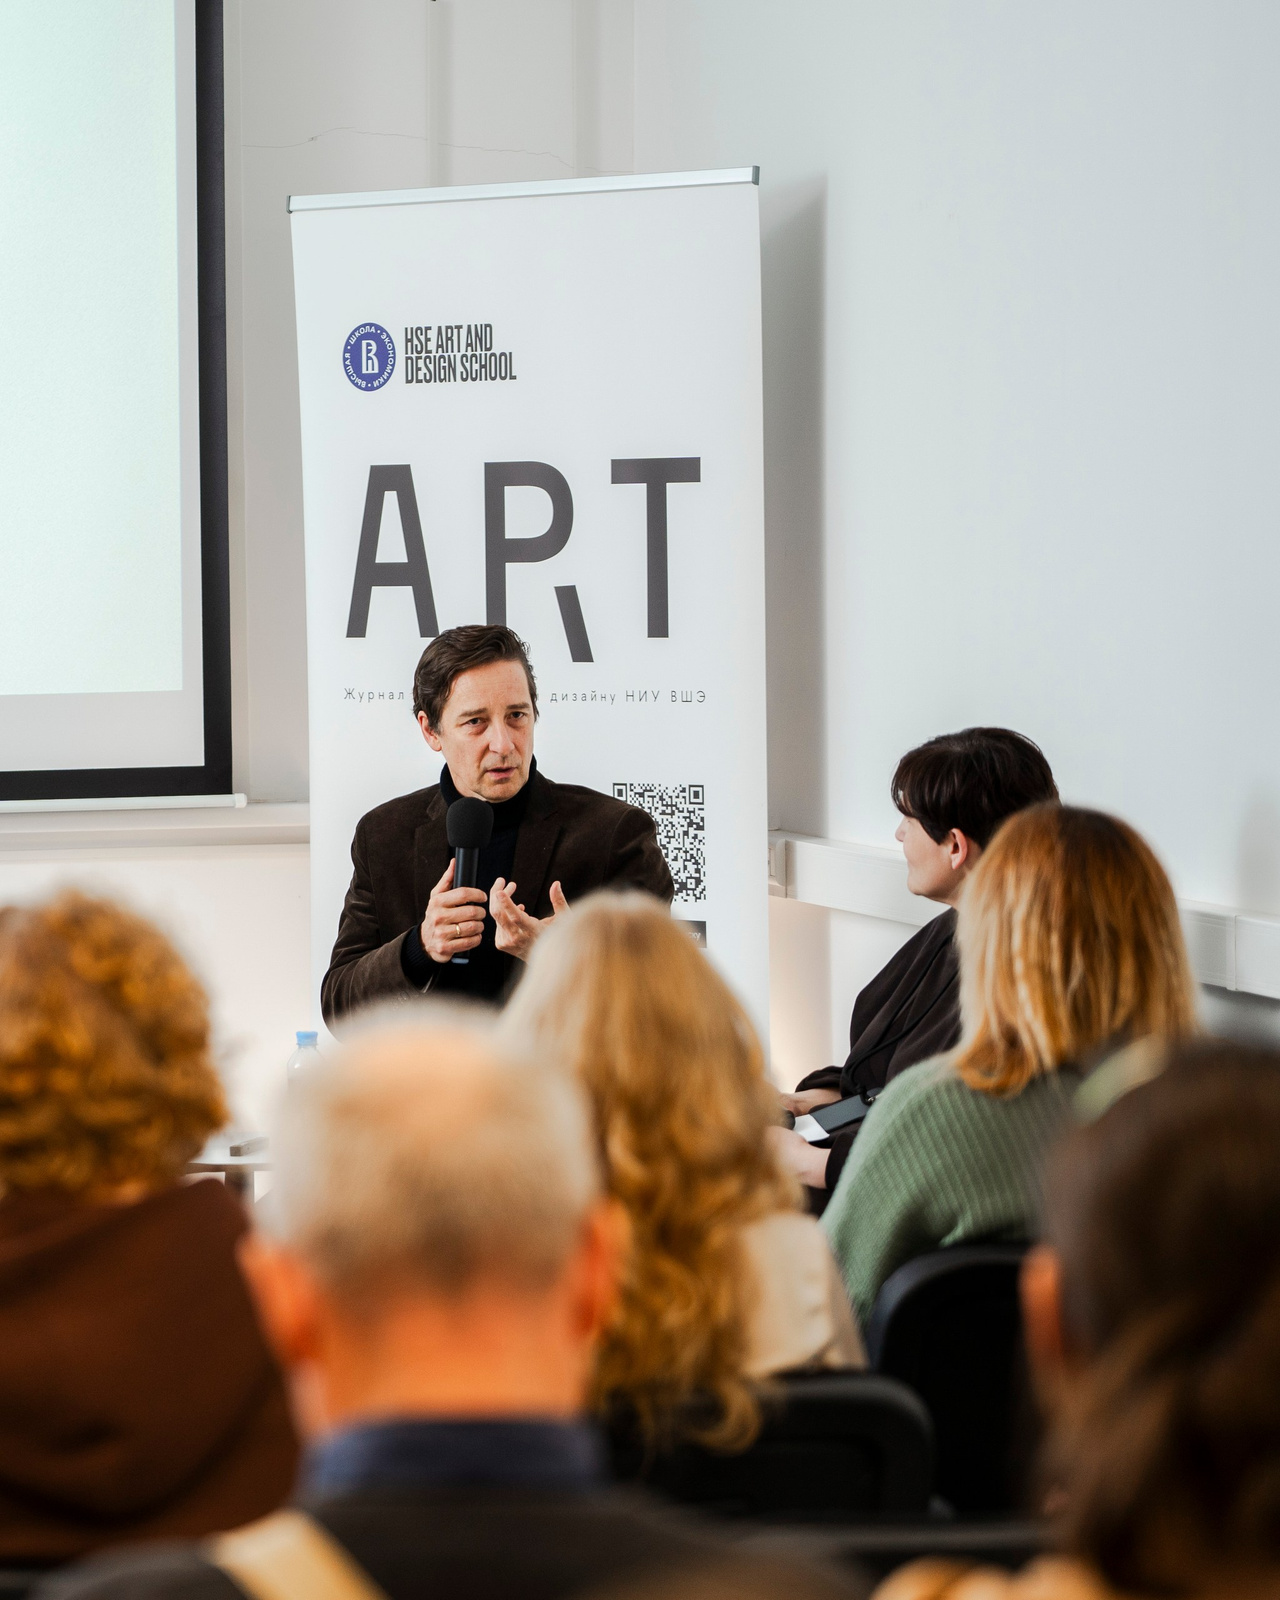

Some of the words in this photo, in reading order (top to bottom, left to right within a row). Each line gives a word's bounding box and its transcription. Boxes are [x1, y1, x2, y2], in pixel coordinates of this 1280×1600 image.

[348, 325, 376, 345] ШКОЛА
[405, 326, 432, 355] HSE
[436, 325, 463, 354] ART
[465, 323, 493, 352] AND
[344, 353, 367, 388] ВЫСШАЯ
[372, 332, 395, 388] ЭКОНОМИКИ
[405, 354, 456, 384] DESIGN
[460, 352, 517, 382] SCHOOL
[345, 456, 701, 663] ART
[344, 687, 404, 703] Журнал
[550, 690, 616, 705] дизайну
[625, 690, 660, 702] НИУ
[671, 690, 706, 703] ВШЭ
